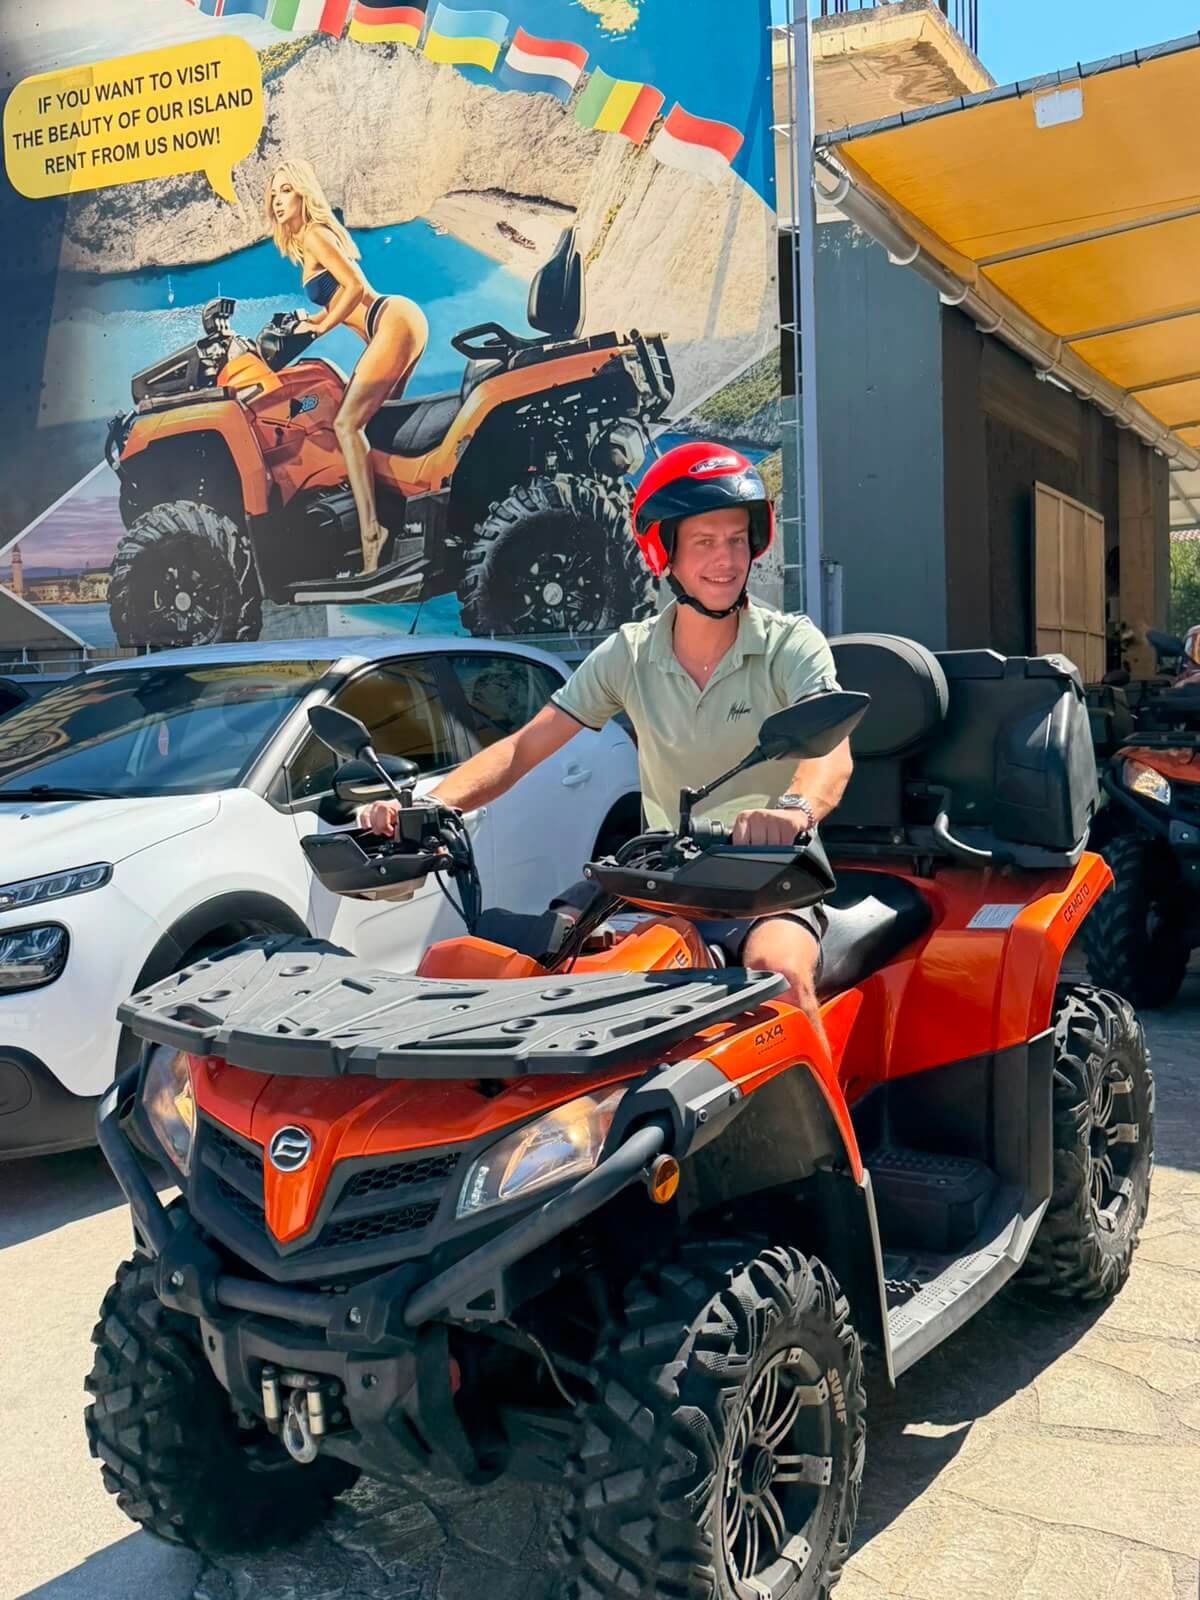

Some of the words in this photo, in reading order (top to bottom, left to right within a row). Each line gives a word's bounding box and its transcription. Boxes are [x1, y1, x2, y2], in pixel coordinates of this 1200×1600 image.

[38, 96, 52, 115] IF
[56, 87, 90, 110] YOU
[95, 76, 144, 102] WANT
[149, 71, 172, 91] TO
[176, 60, 221, 85] VISIT
[12, 129, 44, 150] THE
[48, 114, 113, 143] BEAUTY
[118, 109, 141, 129] OF
[146, 101, 184, 124] OUR
[188, 88, 253, 116] ISLAND
[45, 151, 87, 175] RENT
[91, 141, 140, 167] FROM
[145, 136, 168, 156] US
[172, 126, 221, 151] NOW!
